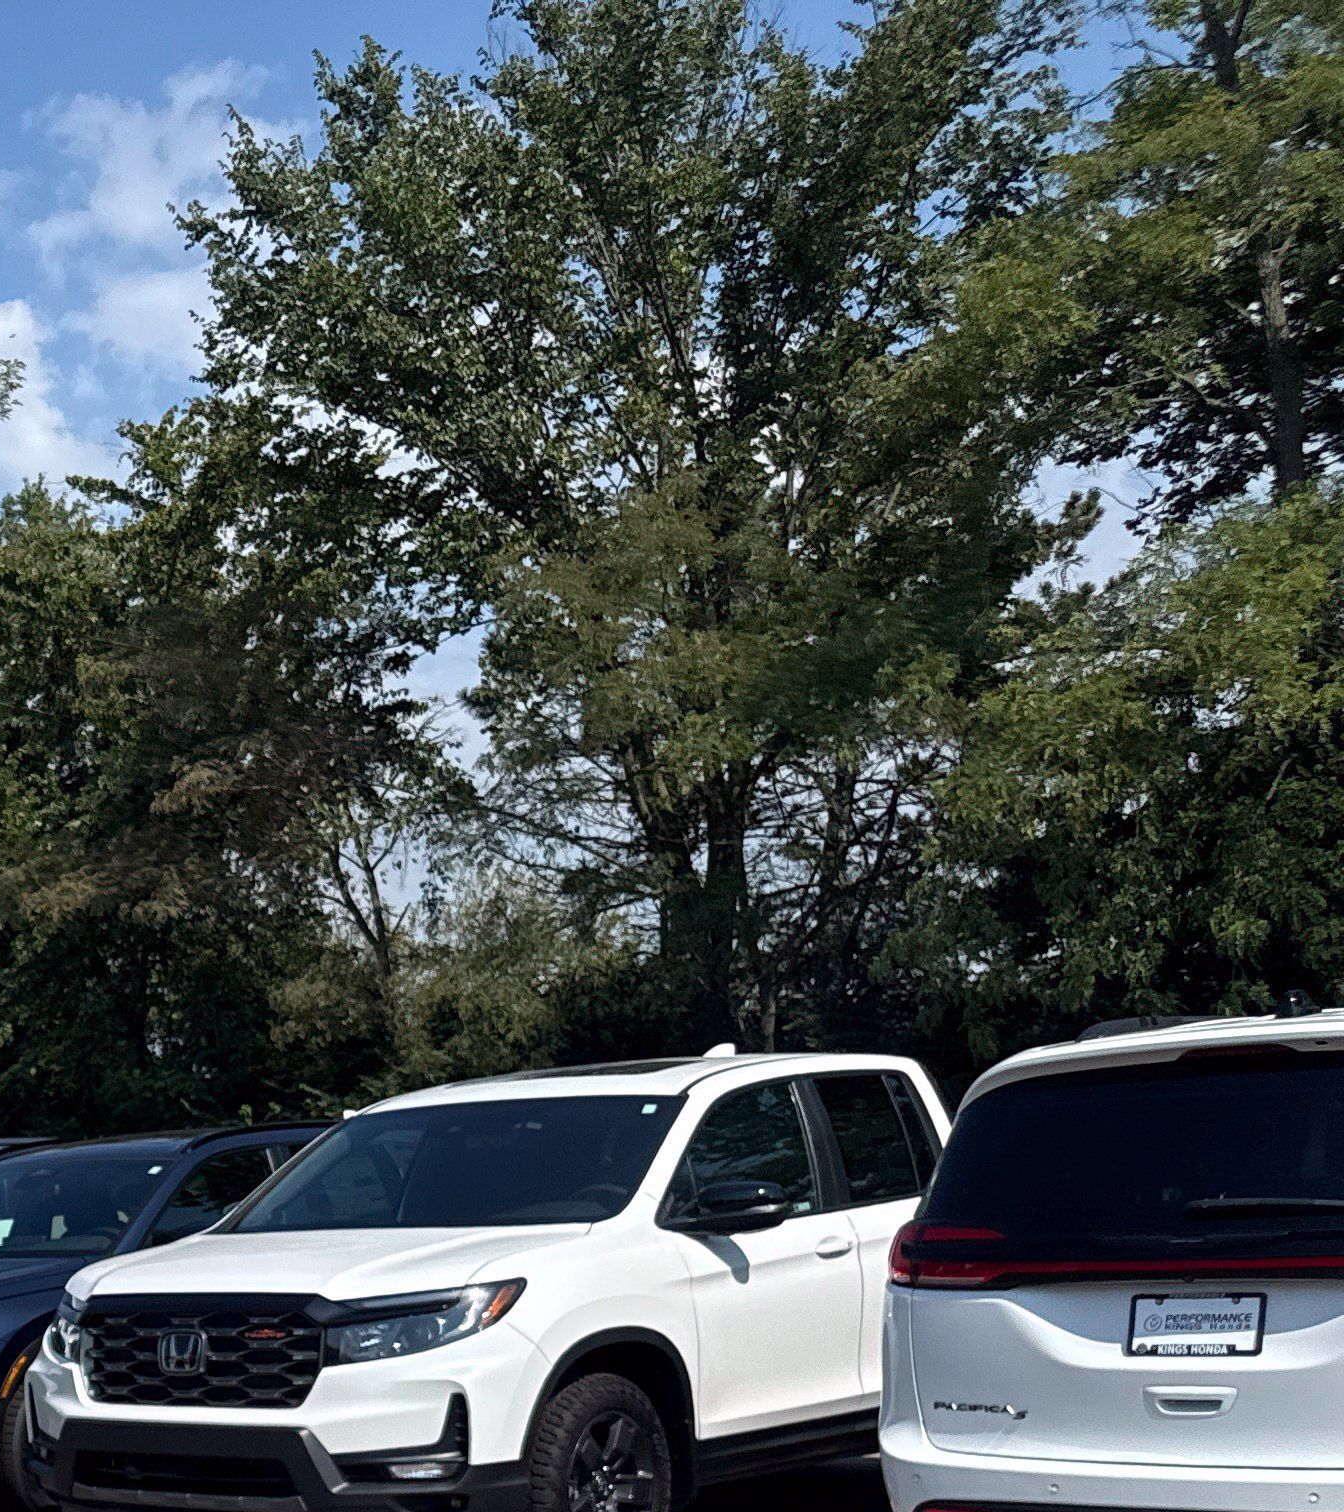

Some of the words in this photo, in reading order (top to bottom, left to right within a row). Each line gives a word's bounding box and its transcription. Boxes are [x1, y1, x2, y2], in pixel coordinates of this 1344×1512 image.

[1165, 1313, 1253, 1323] PERFORMANCE
[1164, 1322, 1203, 1331] KINGS
[1157, 1344, 1188, 1355] KINGS
[1190, 1344, 1229, 1355] HONDA
